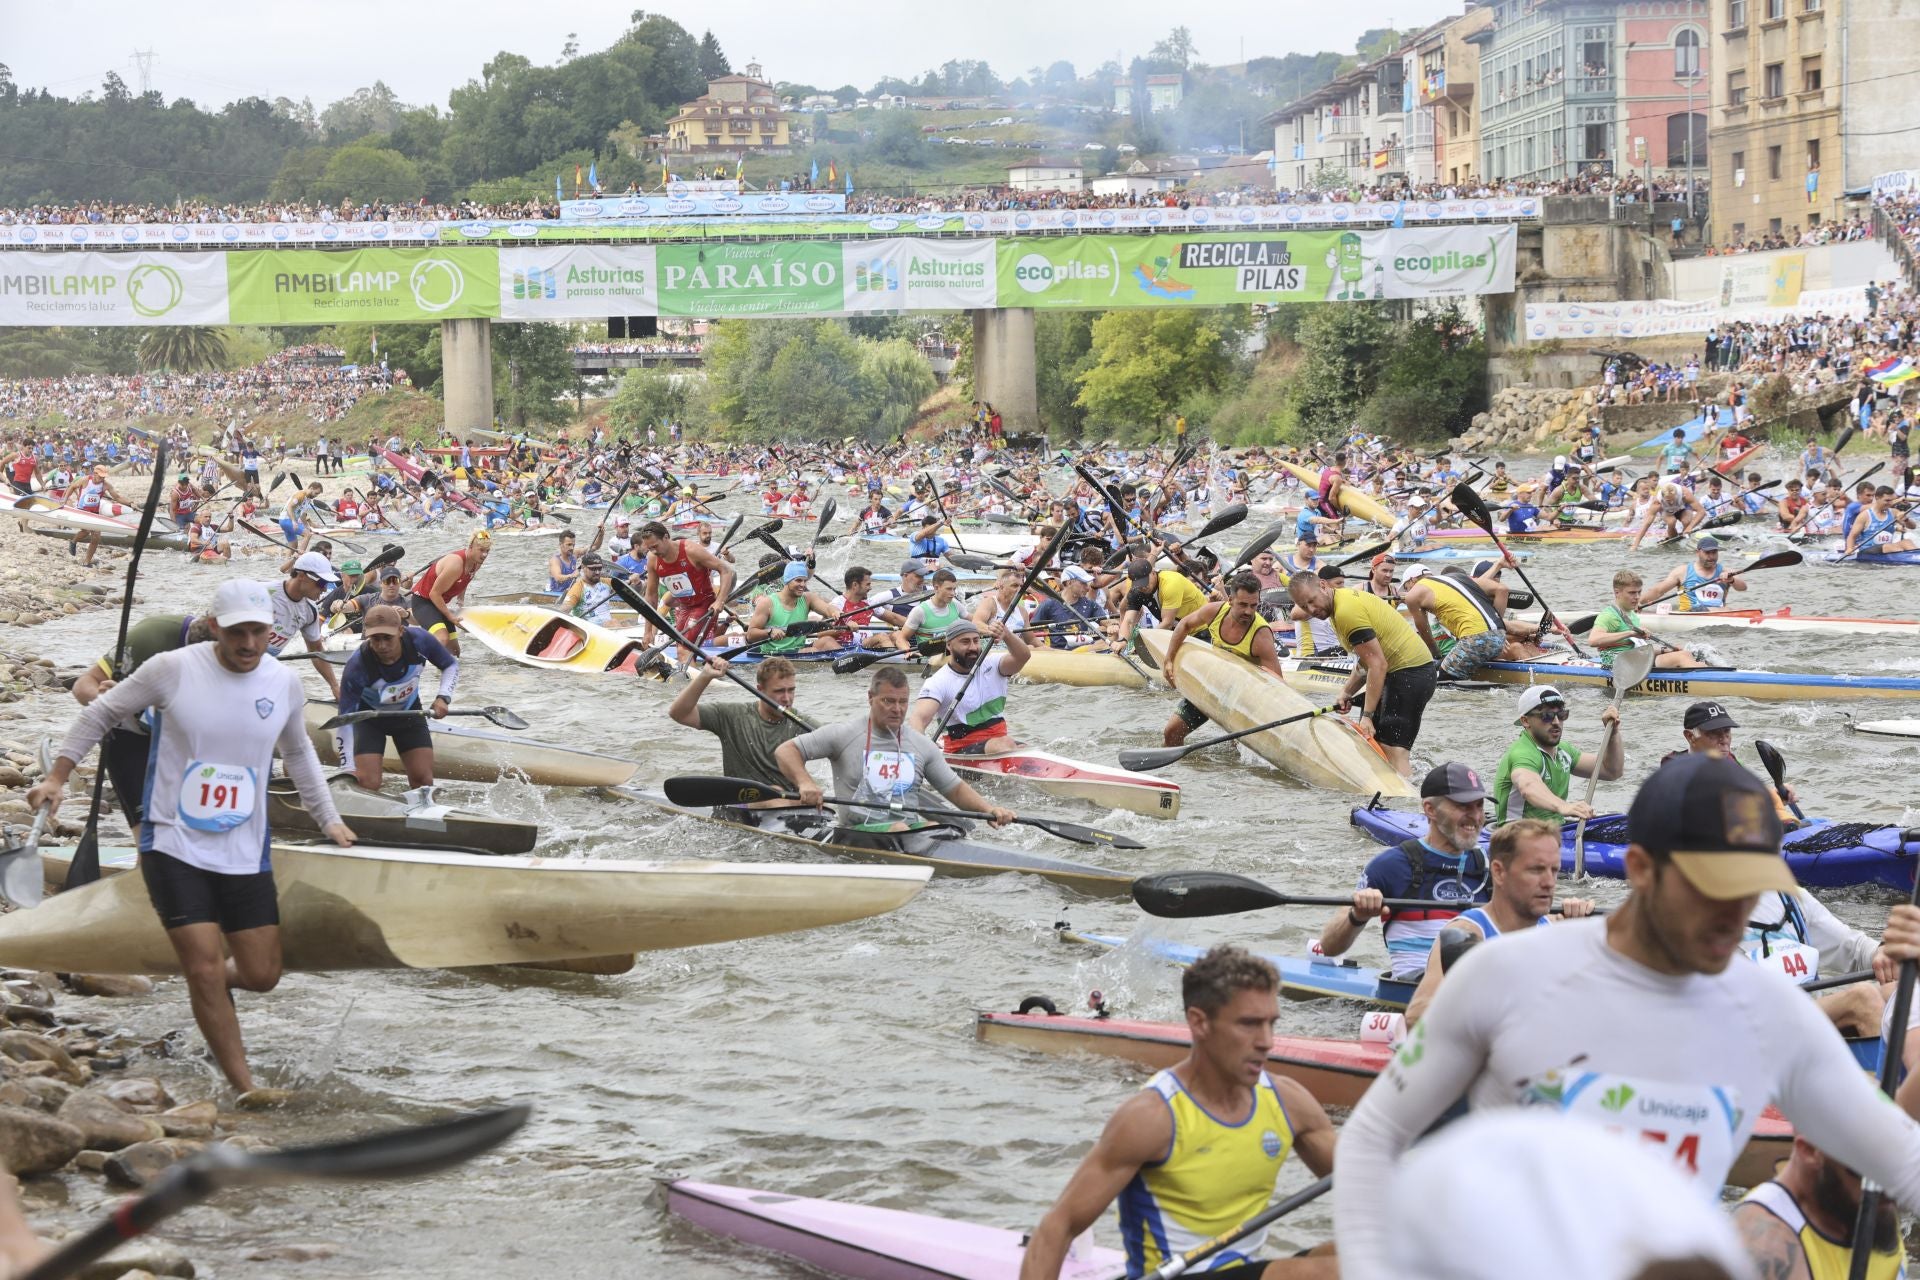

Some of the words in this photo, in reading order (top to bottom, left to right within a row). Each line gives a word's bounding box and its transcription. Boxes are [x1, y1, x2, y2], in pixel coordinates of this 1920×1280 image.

[724, 246, 761, 259] Vuelve
[764, 246, 775, 258] al
[1185, 243, 1269, 267] RECICLA
[1271, 252, 1290, 265] TUS
[908, 256, 984, 276] Asturias
[1394, 251, 1487, 273] ecopilas
[566, 264, 645, 285] Asturias
[664, 258, 836, 290] PARAÍSO
[1015, 260, 1111, 284] ecopilas
[1242, 268, 1299, 290] PILAS
[0, 275, 116, 296] MBILAMP
[275, 271, 400, 293] AMBILAMP
[948, 278, 984, 289] natural
[608, 286, 645, 297] natural
[26, 301, 86, 312] Reciclamos
[88, 302, 98, 311] la
[99, 302, 116, 311] luz
[314, 298, 371, 309] Reciclamos
[373, 298, 382, 307] la
[383, 298, 400, 307] luz
[689, 299, 726, 313] Vuelve
[730, 303, 736, 312] a
[738, 301, 769, 312] sentir
[775, 299, 820, 311] Asturias
[672, 581, 684, 591] 61
[1701, 589, 1718, 599] 149
[731, 637, 740, 645] 72
[1646, 680, 1689, 694] CENTRE
[878, 764, 900, 780] 43
[200, 783, 239, 809] 191
[1782, 953, 1808, 977] 44
[1369, 1014, 1391, 1031] 30
[1639, 1097, 1709, 1125] Unicaja
